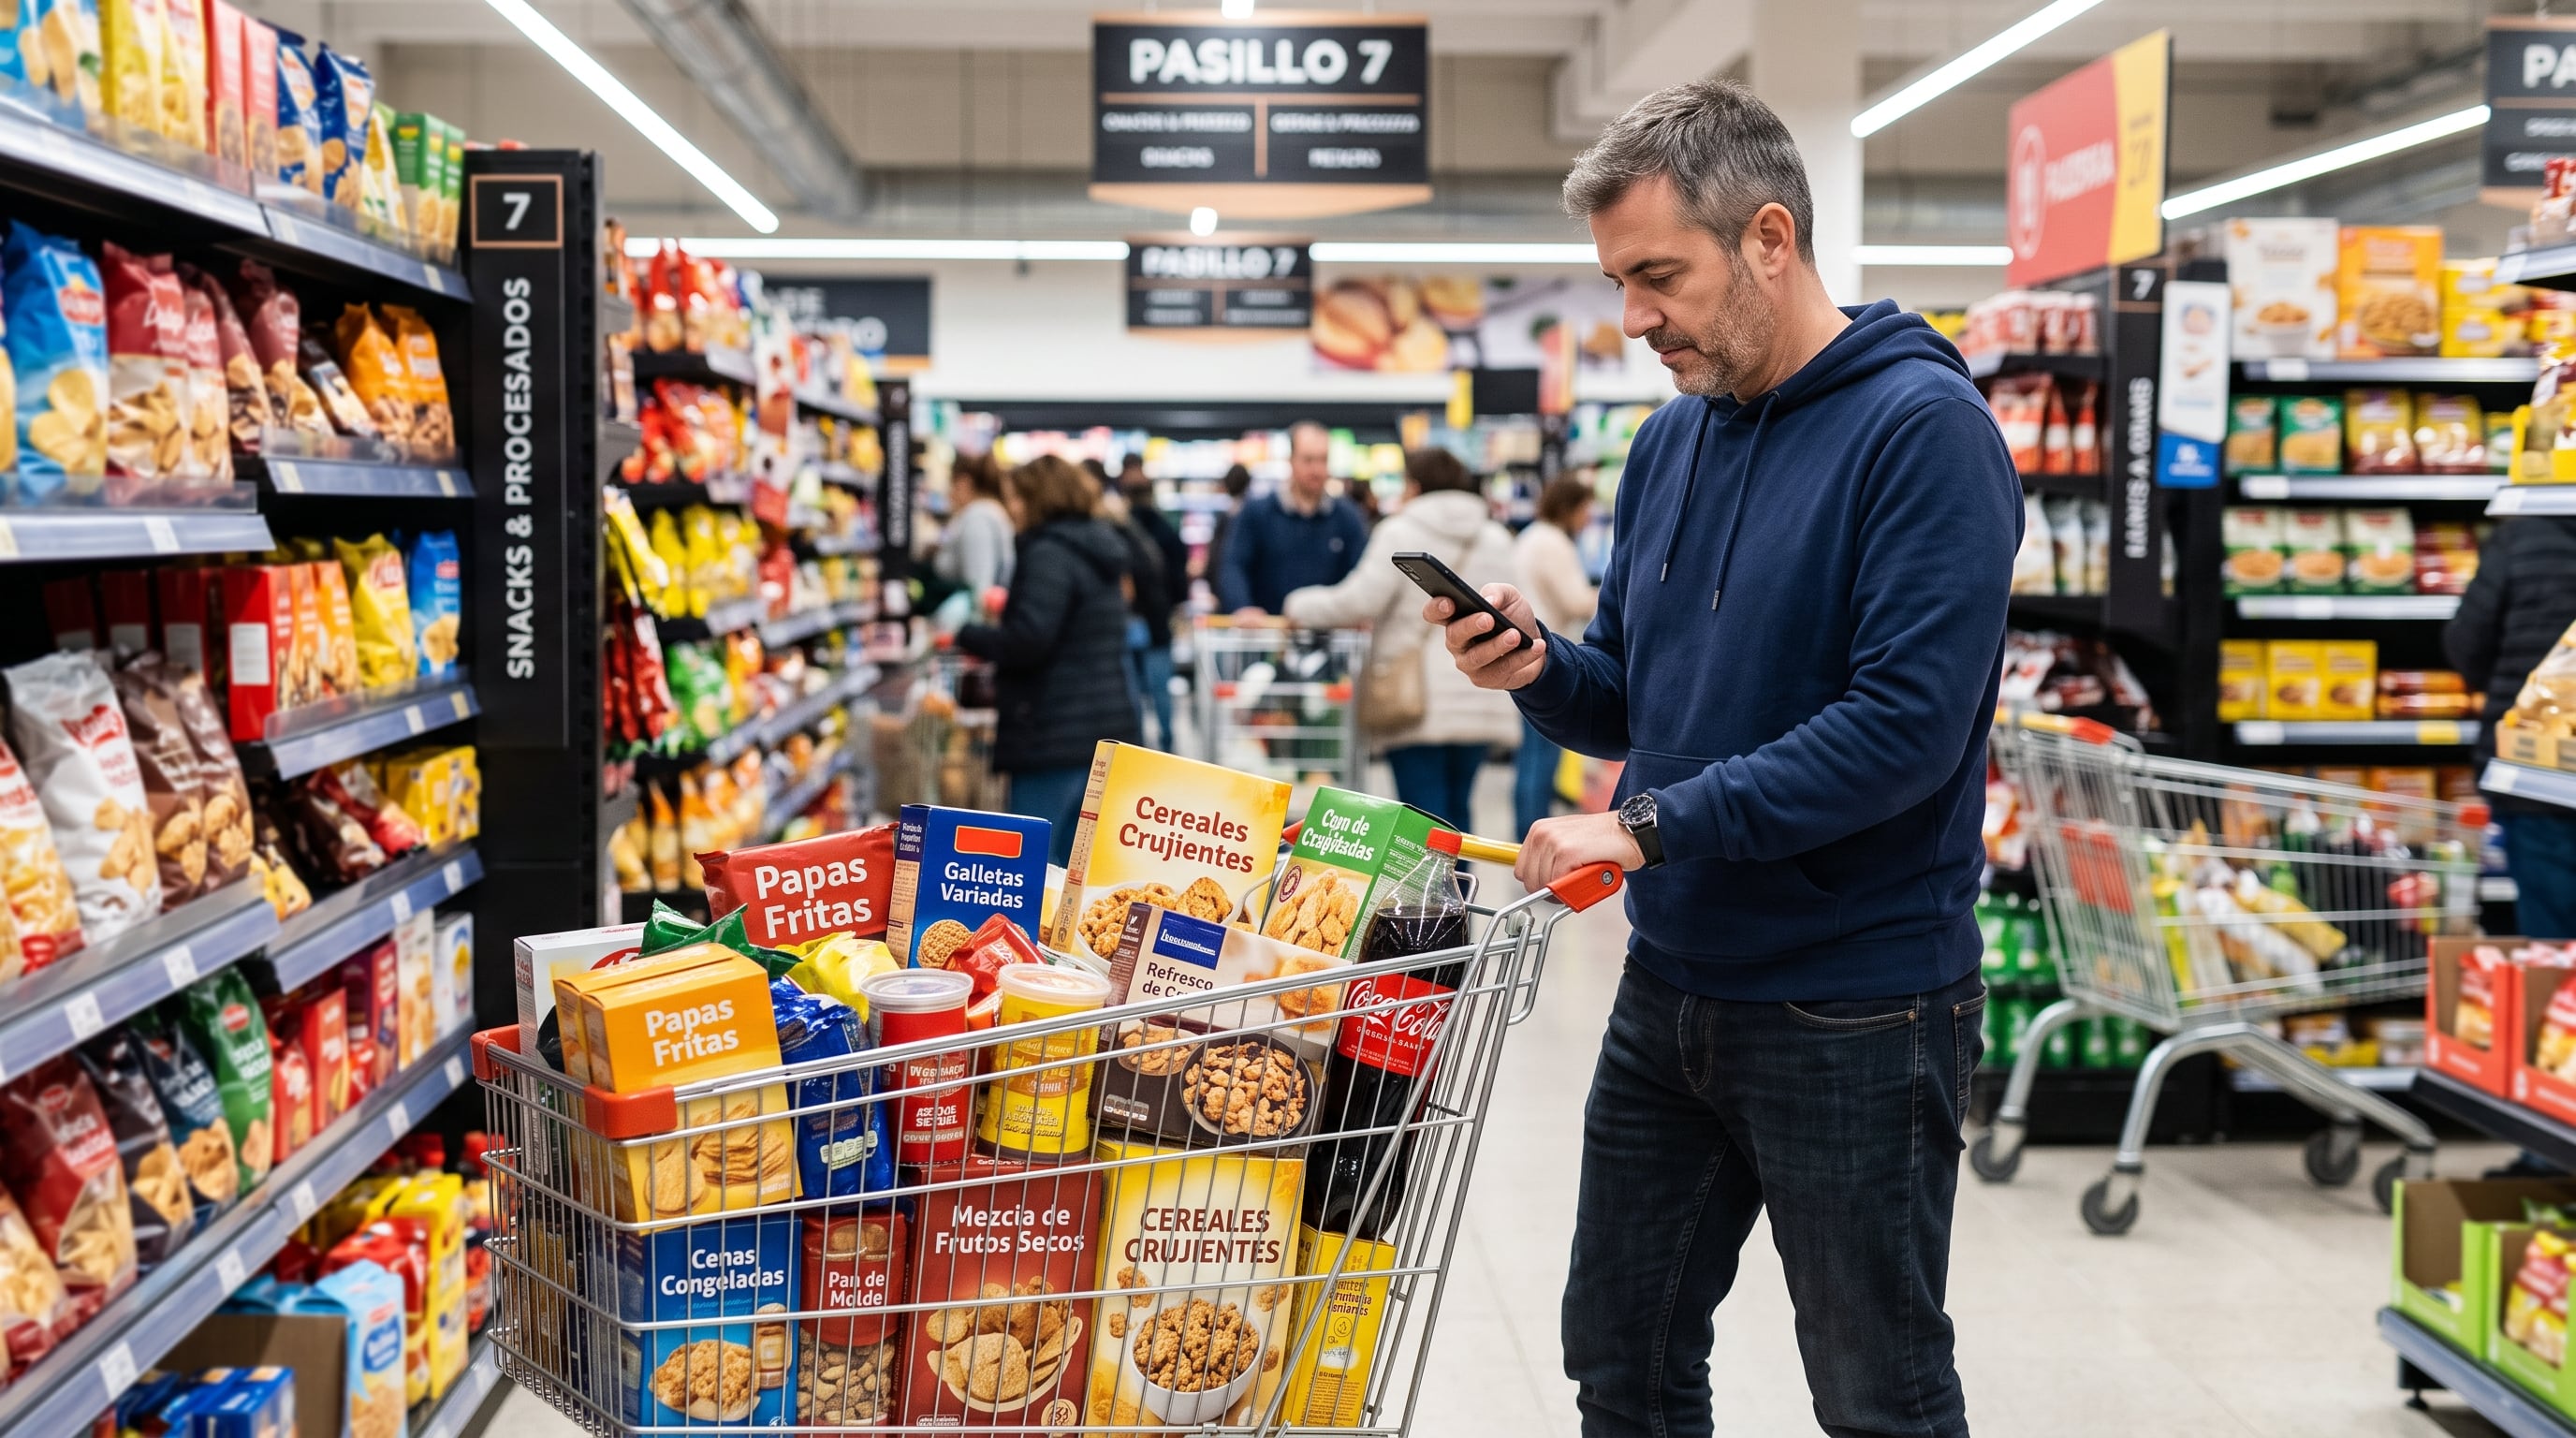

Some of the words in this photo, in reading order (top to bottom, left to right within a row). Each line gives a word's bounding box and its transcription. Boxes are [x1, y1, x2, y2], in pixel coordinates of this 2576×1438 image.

[1128, 37, 1349, 85] PASILLO
[1357, 39, 1394, 85] 7
[503, 192, 532, 231] 7
[1141, 246, 1273, 279] PASILLO
[1273, 246, 1298, 279] 7
[2130, 269, 2157, 301] 7
[503, 277, 533, 506] PROCESADOS
[505, 513, 534, 538] &
[505, 545, 535, 680] SNACKS
[1135, 796, 1249, 843] Cereales
[1351, 815, 1370, 837] de
[1119, 822, 1254, 873] Crujientes
[754, 858, 868, 900] Papas
[944, 861, 1024, 888] Galletas
[940, 883, 1023, 909] Variadas
[764, 897, 872, 939] Fritas
[1142, 980, 1161, 996] de
[1147, 961, 1213, 990] Refresco
[644, 999, 735, 1038] Papas
[652, 1029, 739, 1067] Fritas
[1042, 1203, 1071, 1226] de
[1140, 1208, 1270, 1233] CEREALES
[935, 1231, 1011, 1255] Frutos
[1017, 1230, 1085, 1253] Secos
[1124, 1238, 1281, 1264] CRUJIENTES
[691, 1248, 756, 1269] Cenas
[660, 1267, 784, 1298] Congeladas
[828, 1270, 860, 1288] Pan
[865, 1270, 886, 1288] de
[829, 1289, 883, 1307] Molde
